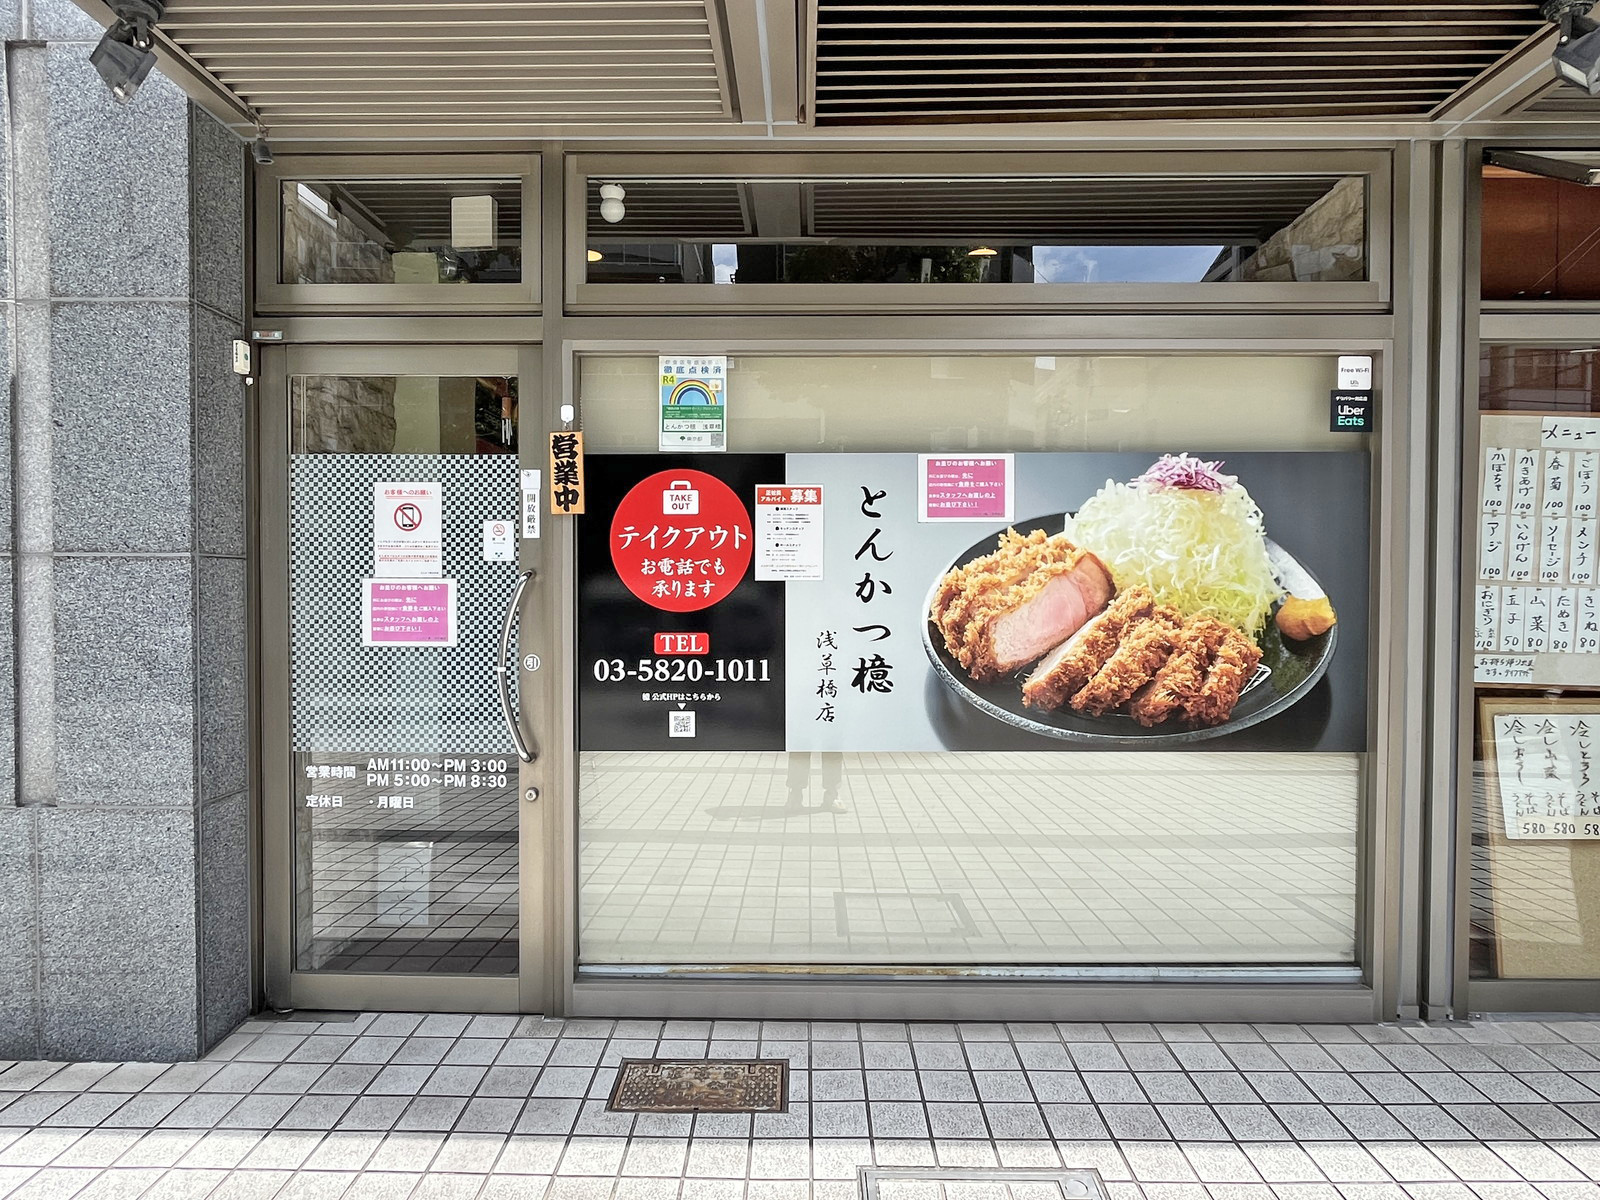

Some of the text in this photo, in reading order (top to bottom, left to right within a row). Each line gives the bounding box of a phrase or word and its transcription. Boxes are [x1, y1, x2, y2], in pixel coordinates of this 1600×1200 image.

[662, 376, 675, 384] R4
[1338, 404, 1364, 415] Uber
[1338, 416, 1364, 426] Eats
[1545, 424, 1597, 440] メニュー
[552, 433, 580, 512] 営業中
[1492, 454, 1506, 492] かぼちゃ
[1518, 456, 1534, 496] かきあげ
[1548, 456, 1564, 491] 春菊
[1578, 458, 1594, 494] ごぼう
[670, 494, 692, 502] TAKE
[790, 488, 818, 503] 募集
[526, 494, 536, 534] 開放厳禁
[618, 525, 747, 550] テイクアウト
[1487, 522, 1502, 553] アジ
[1516, 523, 1530, 562] いんげん
[1546, 526, 1561, 567] ソーセージ
[1576, 527, 1590, 566] メンチ
[640, 558, 726, 576] お電話でも
[1572, 572, 1590, 580] 100
[652, 580, 716, 598] 承ります
[851, 486, 894, 694] とんかつ檍
[1481, 590, 1494, 626] おにぎり
[1530, 596, 1546, 632] 山菜
[1557, 596, 1570, 632] たぬき
[1584, 596, 1598, 632] きつね
[660, 634, 703, 652] TEL
[1476, 640, 1492, 648] 110
[1504, 636, 1519, 646] 50
[1528, 638, 1543, 648] 80
[1554, 640, 1568, 649] 80
[1580, 637, 1596, 648] 80
[594, 658, 771, 682] 03-5820-1011
[815, 630, 838, 723] 浅草橋店
[652, 692, 721, 701] 公式HPはこちらから
[306, 765, 356, 778] 営業時間
[470, 759, 508, 772] 3:00
[366, 774, 389, 786] PM
[470, 774, 508, 788] 8:30
[306, 795, 342, 807] 定休日
[1523, 822, 1546, 835] 580
[1554, 822, 1576, 835] 580
